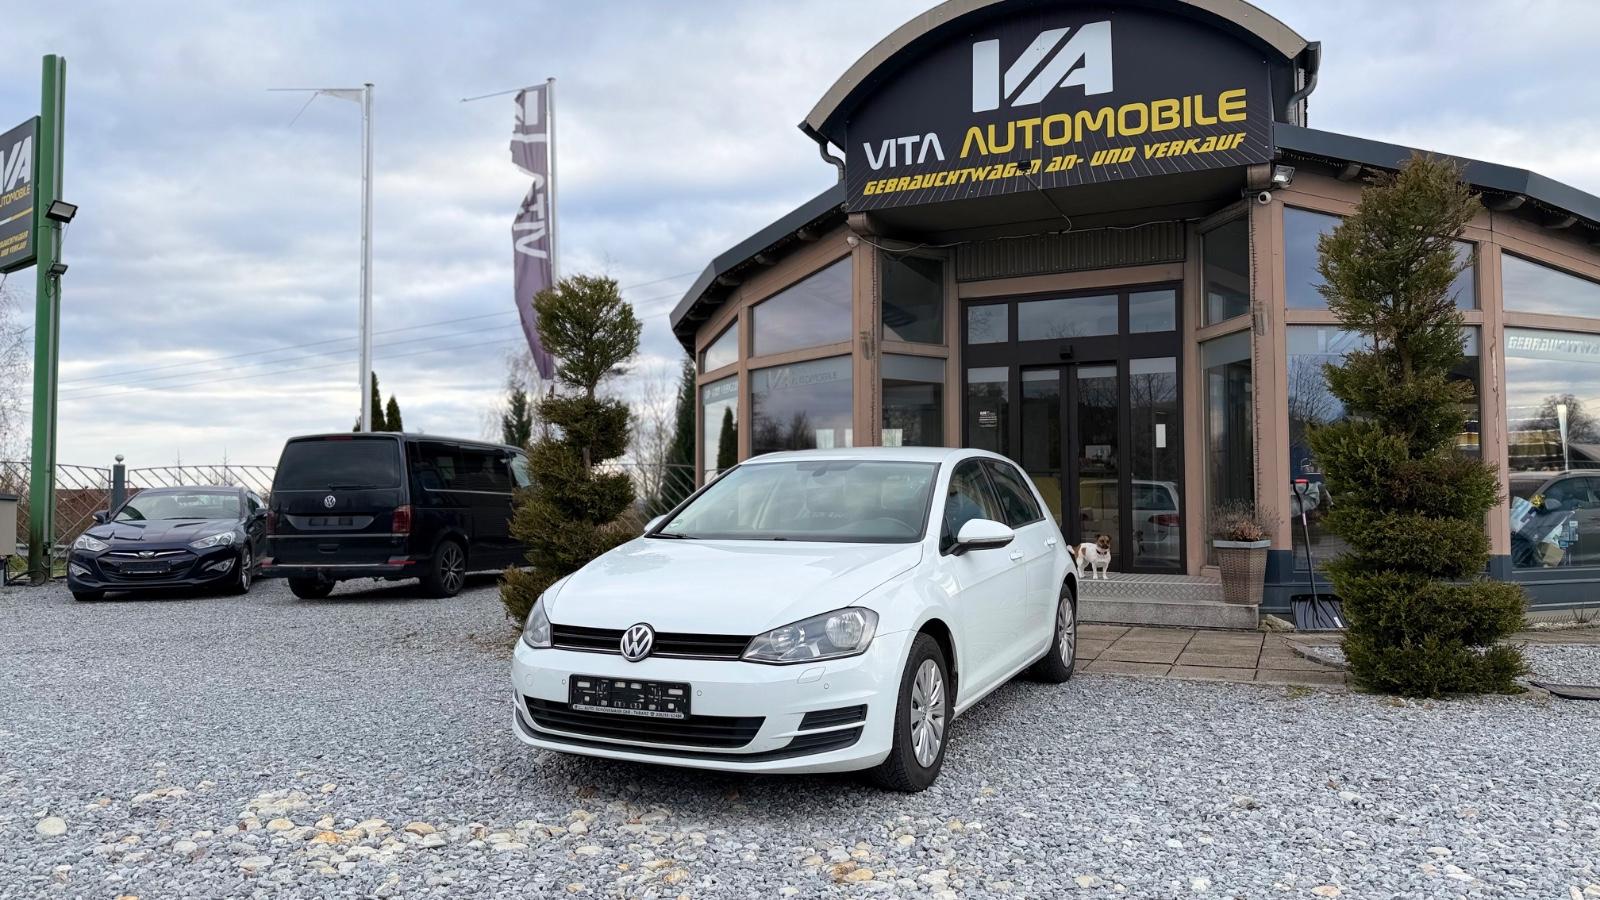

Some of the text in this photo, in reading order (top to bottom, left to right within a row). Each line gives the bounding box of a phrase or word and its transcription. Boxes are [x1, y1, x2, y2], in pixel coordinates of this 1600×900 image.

[863, 88, 1247, 170] VITA AUTOMOBILE
[1090, 146, 1136, 167] UND
[1144, 132, 1247, 160] VERKAUF
